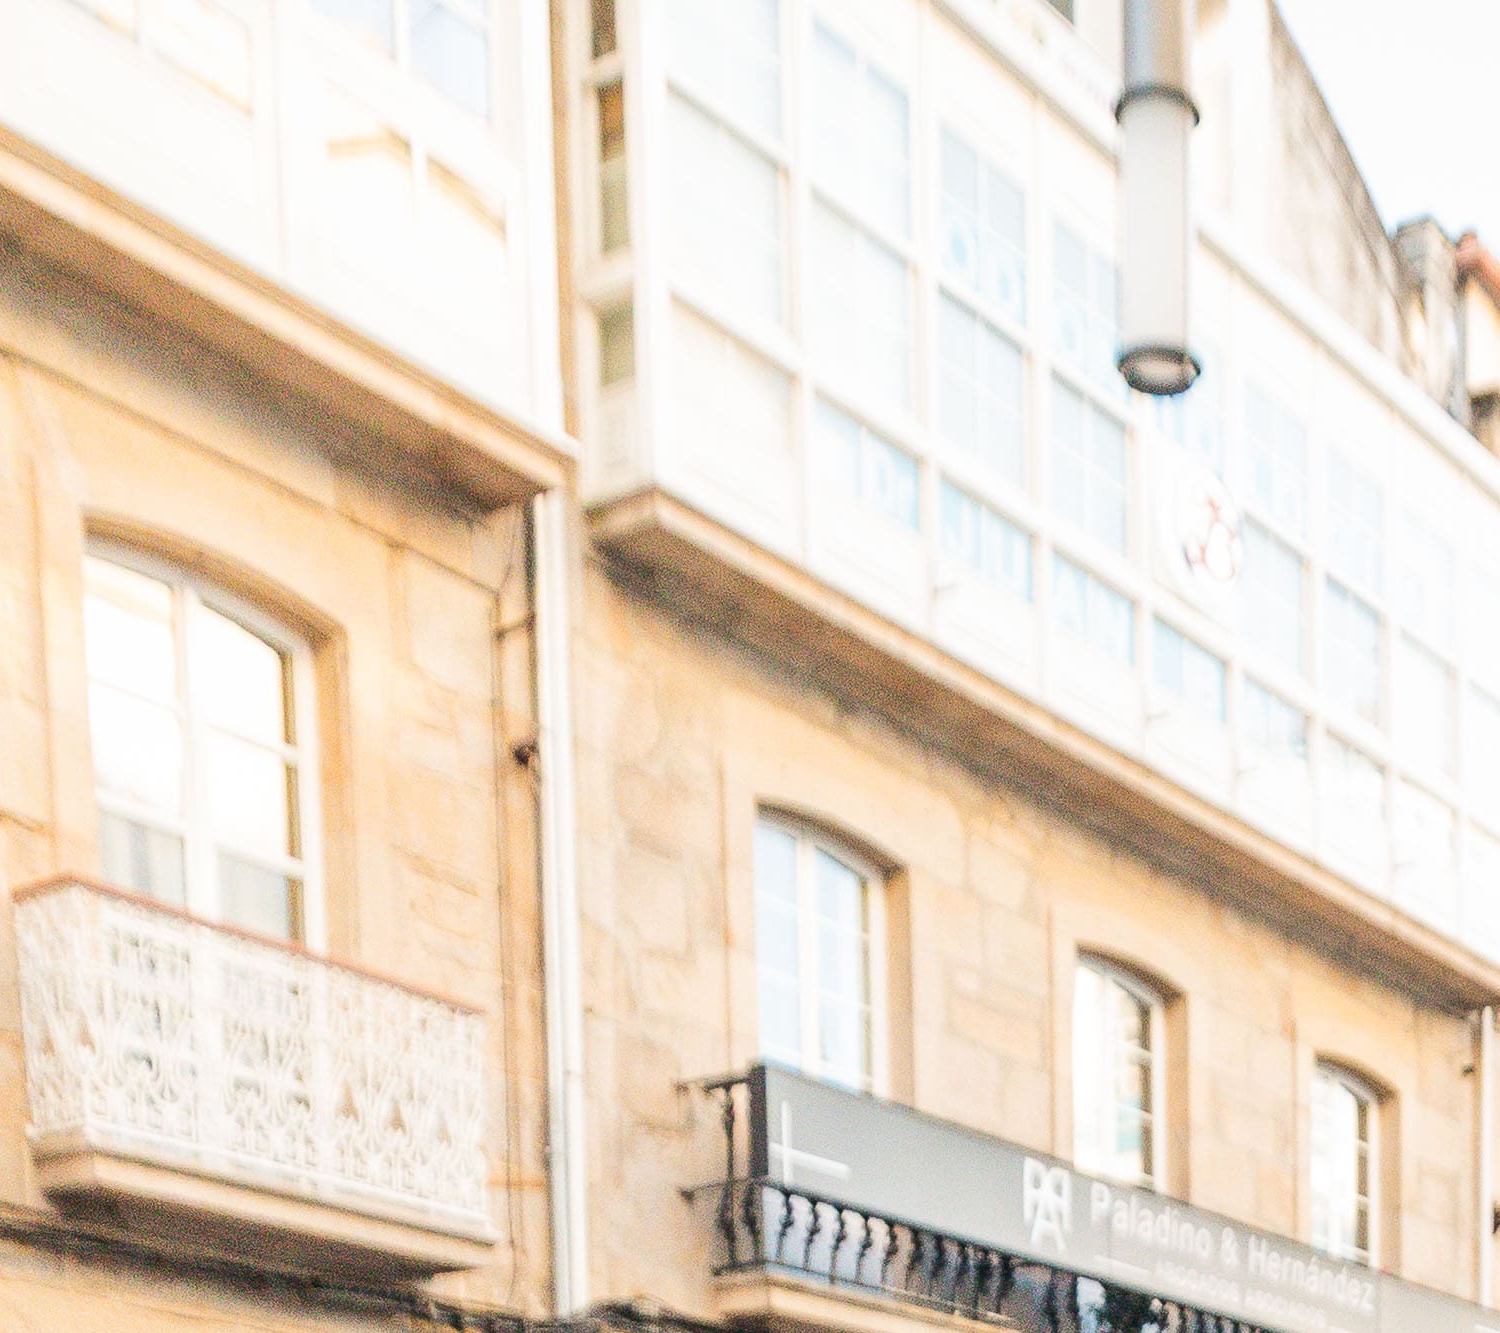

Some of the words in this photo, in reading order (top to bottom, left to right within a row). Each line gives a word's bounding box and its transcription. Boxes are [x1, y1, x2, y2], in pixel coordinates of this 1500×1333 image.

[1091, 1181, 1212, 1260] Paladino
[1220, 1226, 1239, 1265] &
[1248, 1233, 1375, 1312] Hernández
